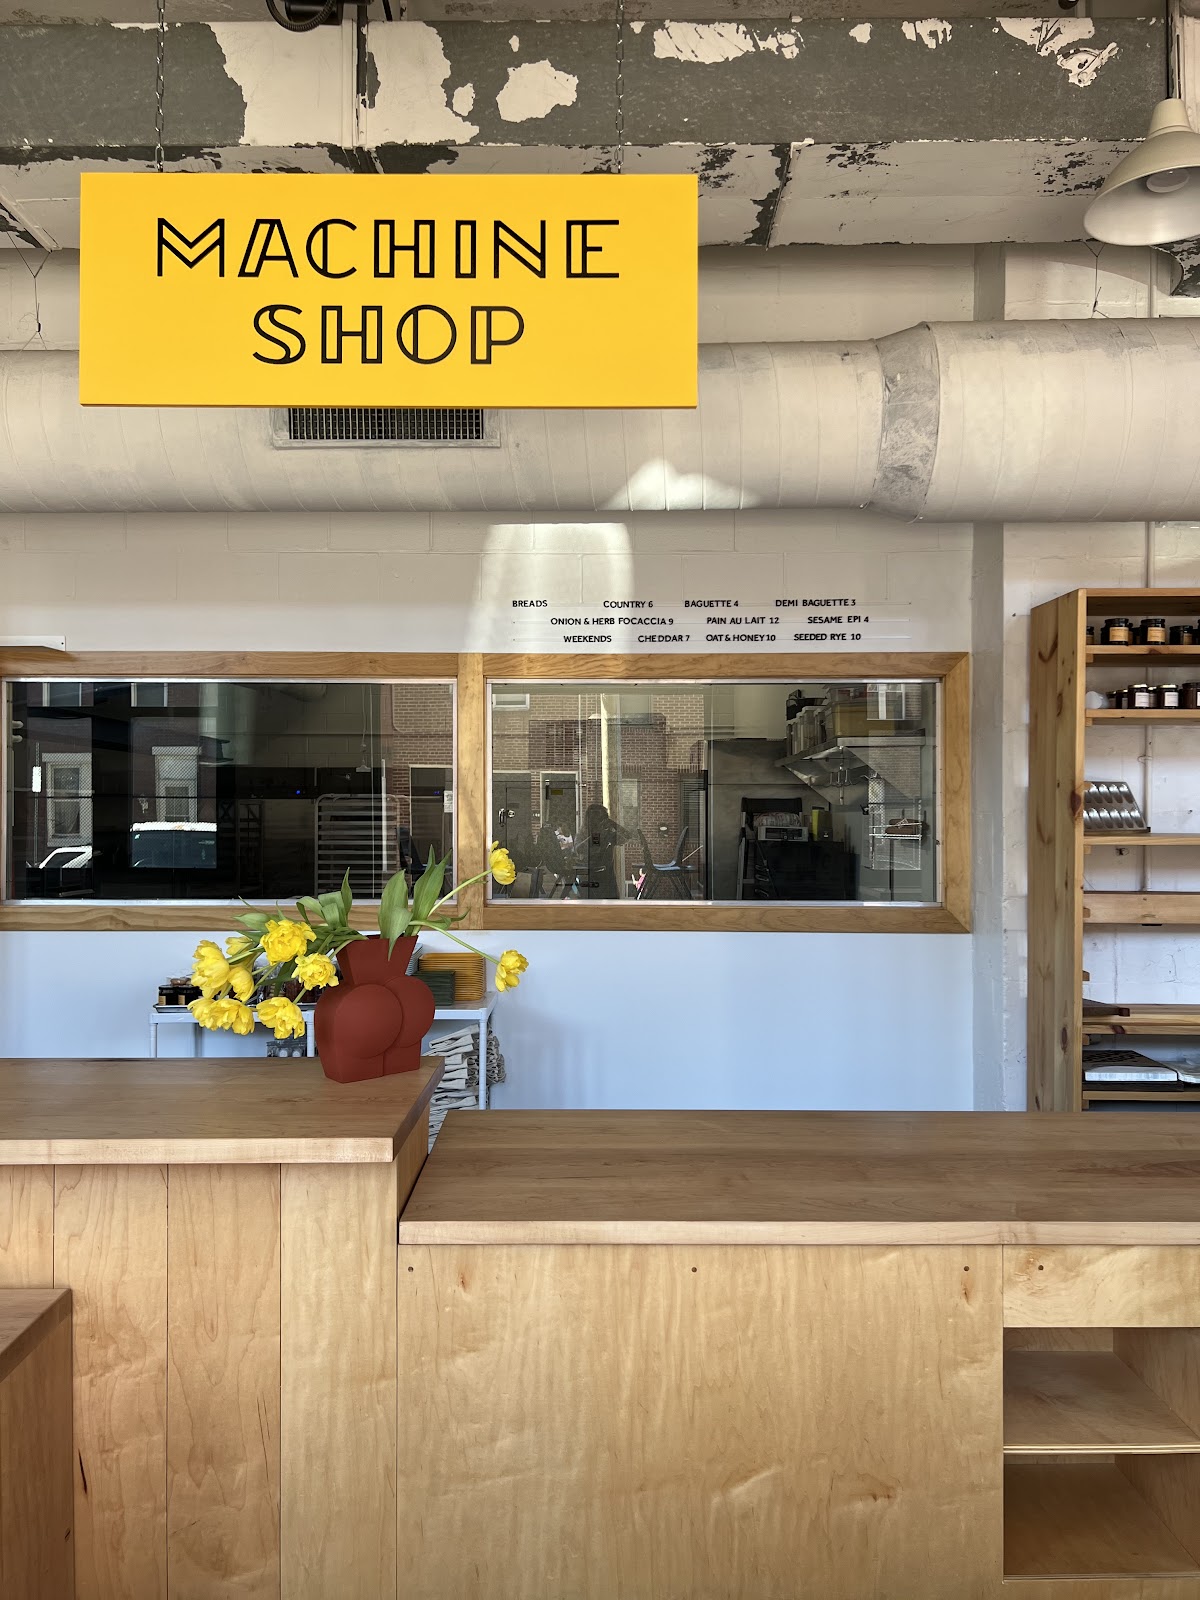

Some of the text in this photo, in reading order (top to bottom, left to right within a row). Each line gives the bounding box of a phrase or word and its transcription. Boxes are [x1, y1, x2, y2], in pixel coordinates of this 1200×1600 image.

[157, 217, 620, 279] MACHINE
[252, 304, 525, 365] SHOP
[512, 600, 548, 608] BREADS
[602, 600, 646, 608] COUNTRY
[684, 600, 732, 608] BAGUETTE
[802, 598, 850, 606] BAGUETTE
[850, 598, 856, 606] 3
[550, 618, 582, 626] ONION
[584, 618, 590, 626] &
[592, 618, 616, 626] HERB
[618, 617, 666, 626] FOCACCIA
[668, 618, 674, 626] 9
[706, 616, 726, 624] PAIN
[744, 616, 766, 624] LAIT
[769, 616, 780, 624] 12
[808, 616, 842, 624] SESAME
[847, 616, 862, 624] EPI
[563, 634, 612, 643] WEEKENDS
[638, 634, 684, 642] CHEDDAR
[793, 633, 828, 642] SEEDED
[830, 632, 848, 641] RYE
